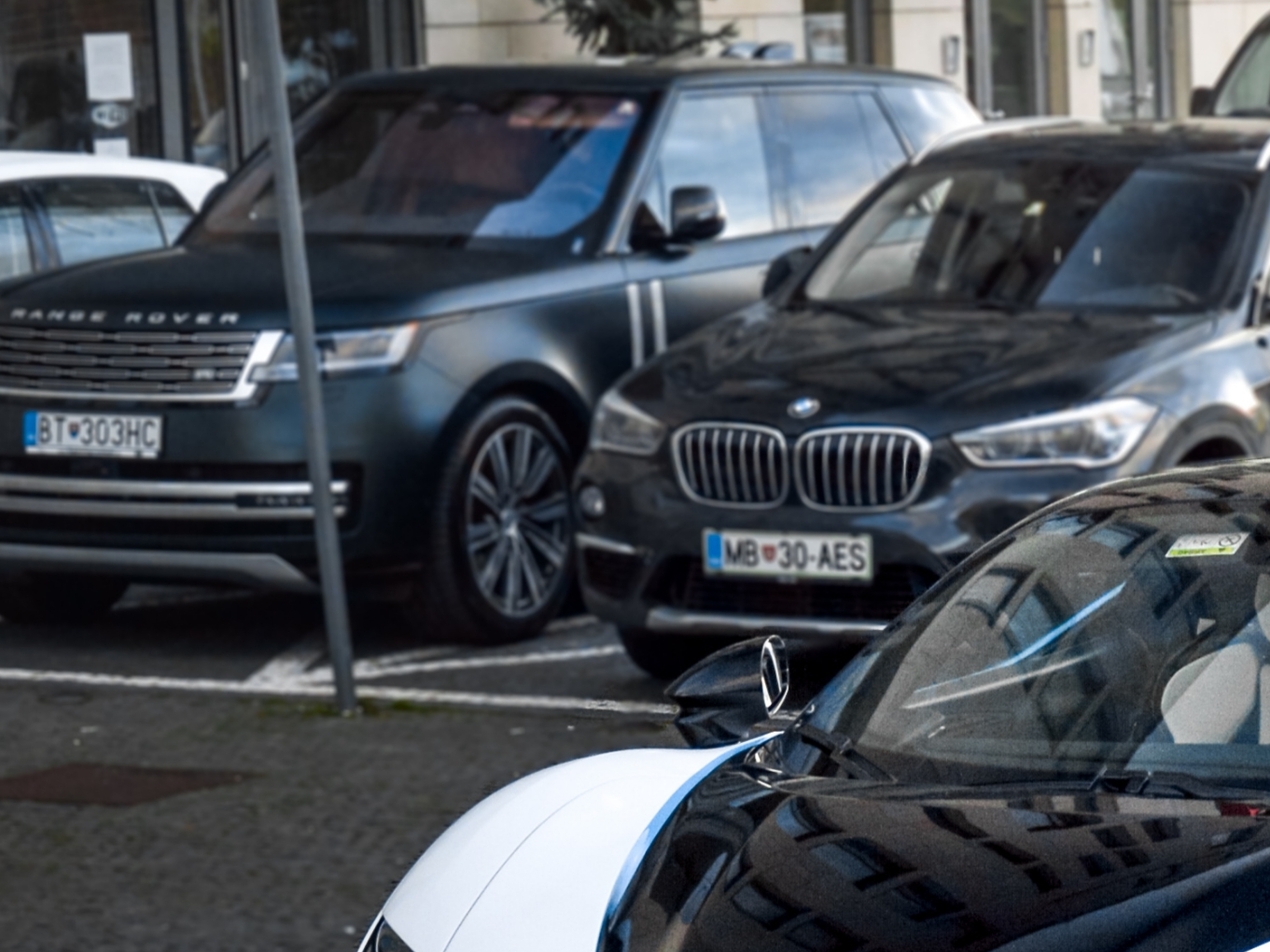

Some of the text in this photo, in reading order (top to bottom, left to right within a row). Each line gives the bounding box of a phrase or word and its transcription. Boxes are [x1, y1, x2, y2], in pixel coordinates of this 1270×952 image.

[11, 308, 240, 325] RANGE ROVER
[40, 415, 156, 447] BT 303HC
[724, 537, 867, 571] MB 30-AES
